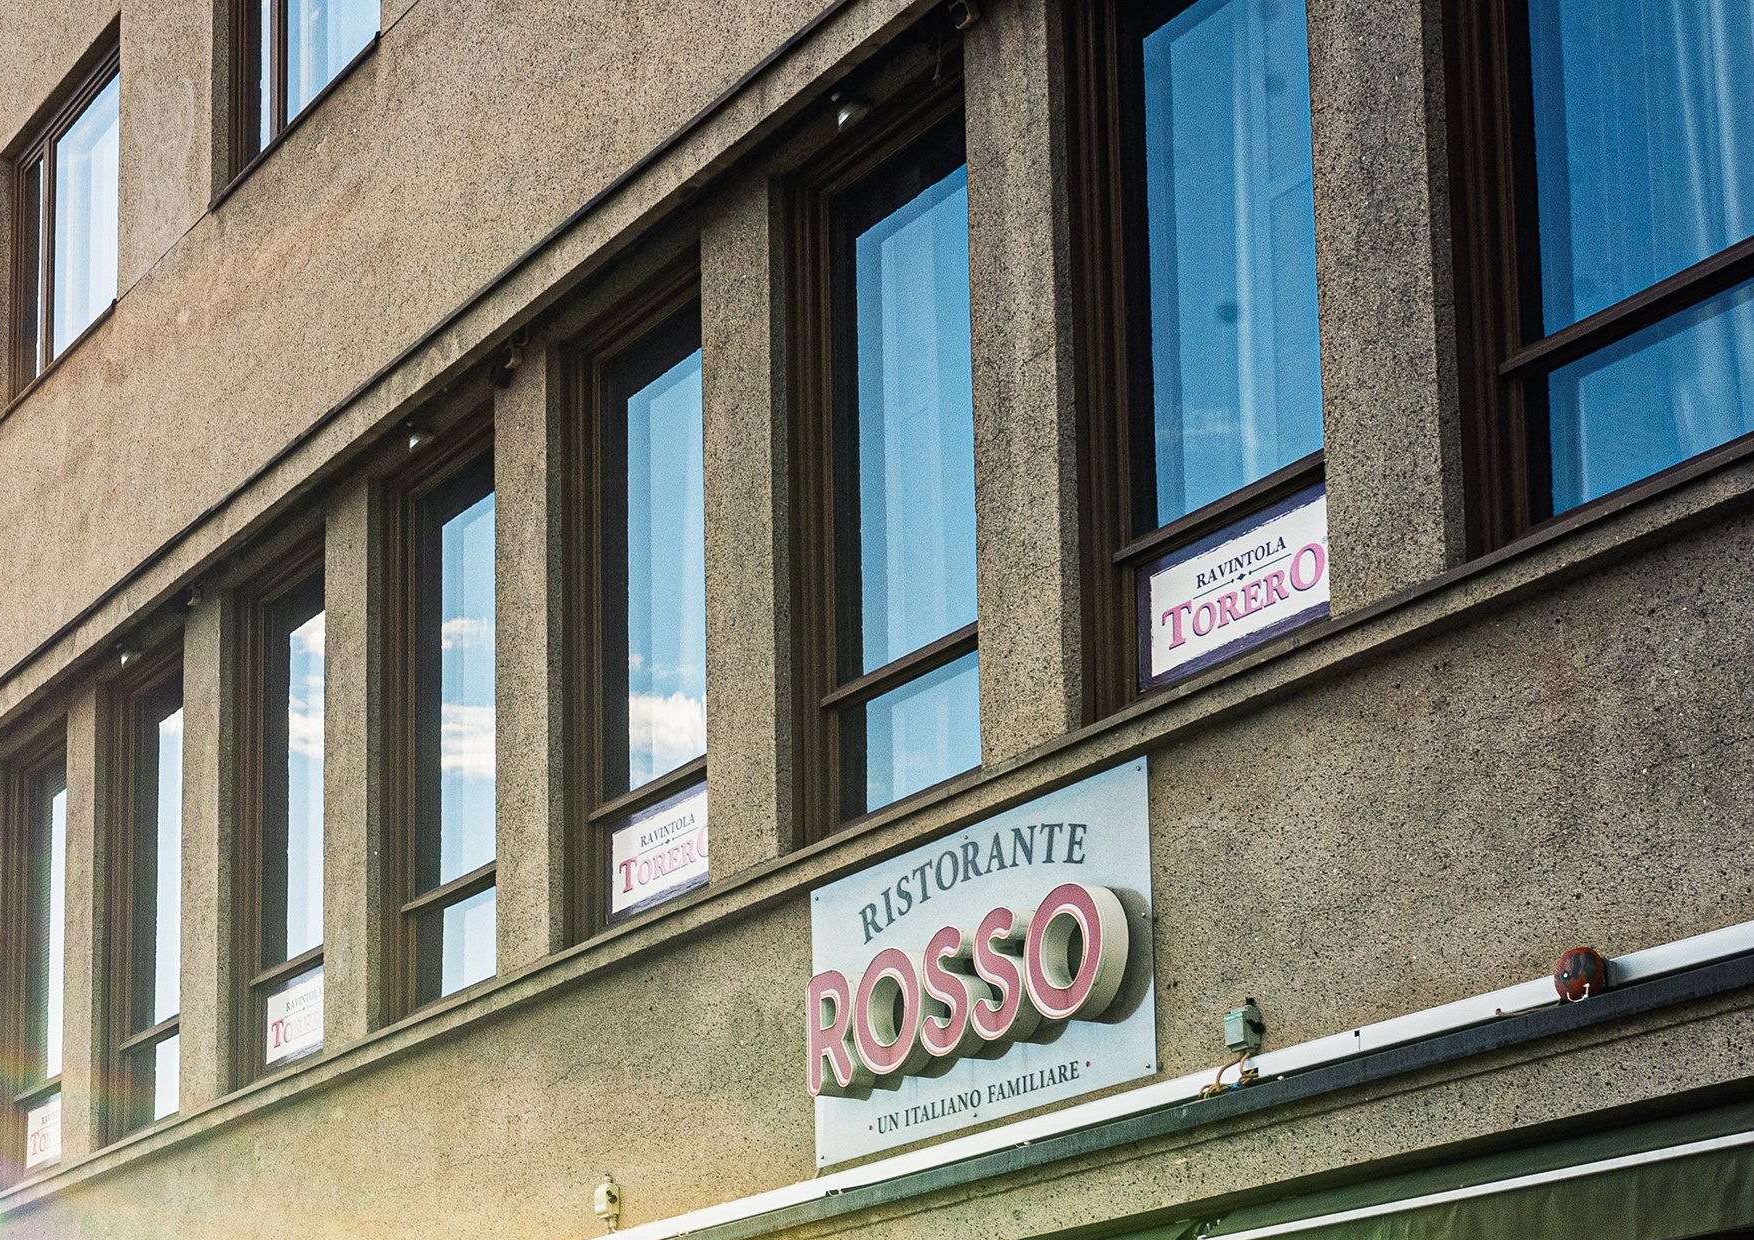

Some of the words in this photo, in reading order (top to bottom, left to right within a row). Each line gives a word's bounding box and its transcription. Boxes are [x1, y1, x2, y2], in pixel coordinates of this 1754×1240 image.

[1161, 542, 1326, 650] TORERO
[1196, 536, 1287, 590] RAVINTOLA
[640, 813, 695, 848] RAVINTOLA
[859, 822, 1088, 945] RISTORANTE
[806, 882, 1108, 1097] ROSSO
[877, 1114, 899, 1135] UN
[904, 1088, 981, 1128] ITALIANO
[987, 1060, 1080, 1105] FAMILIARE
